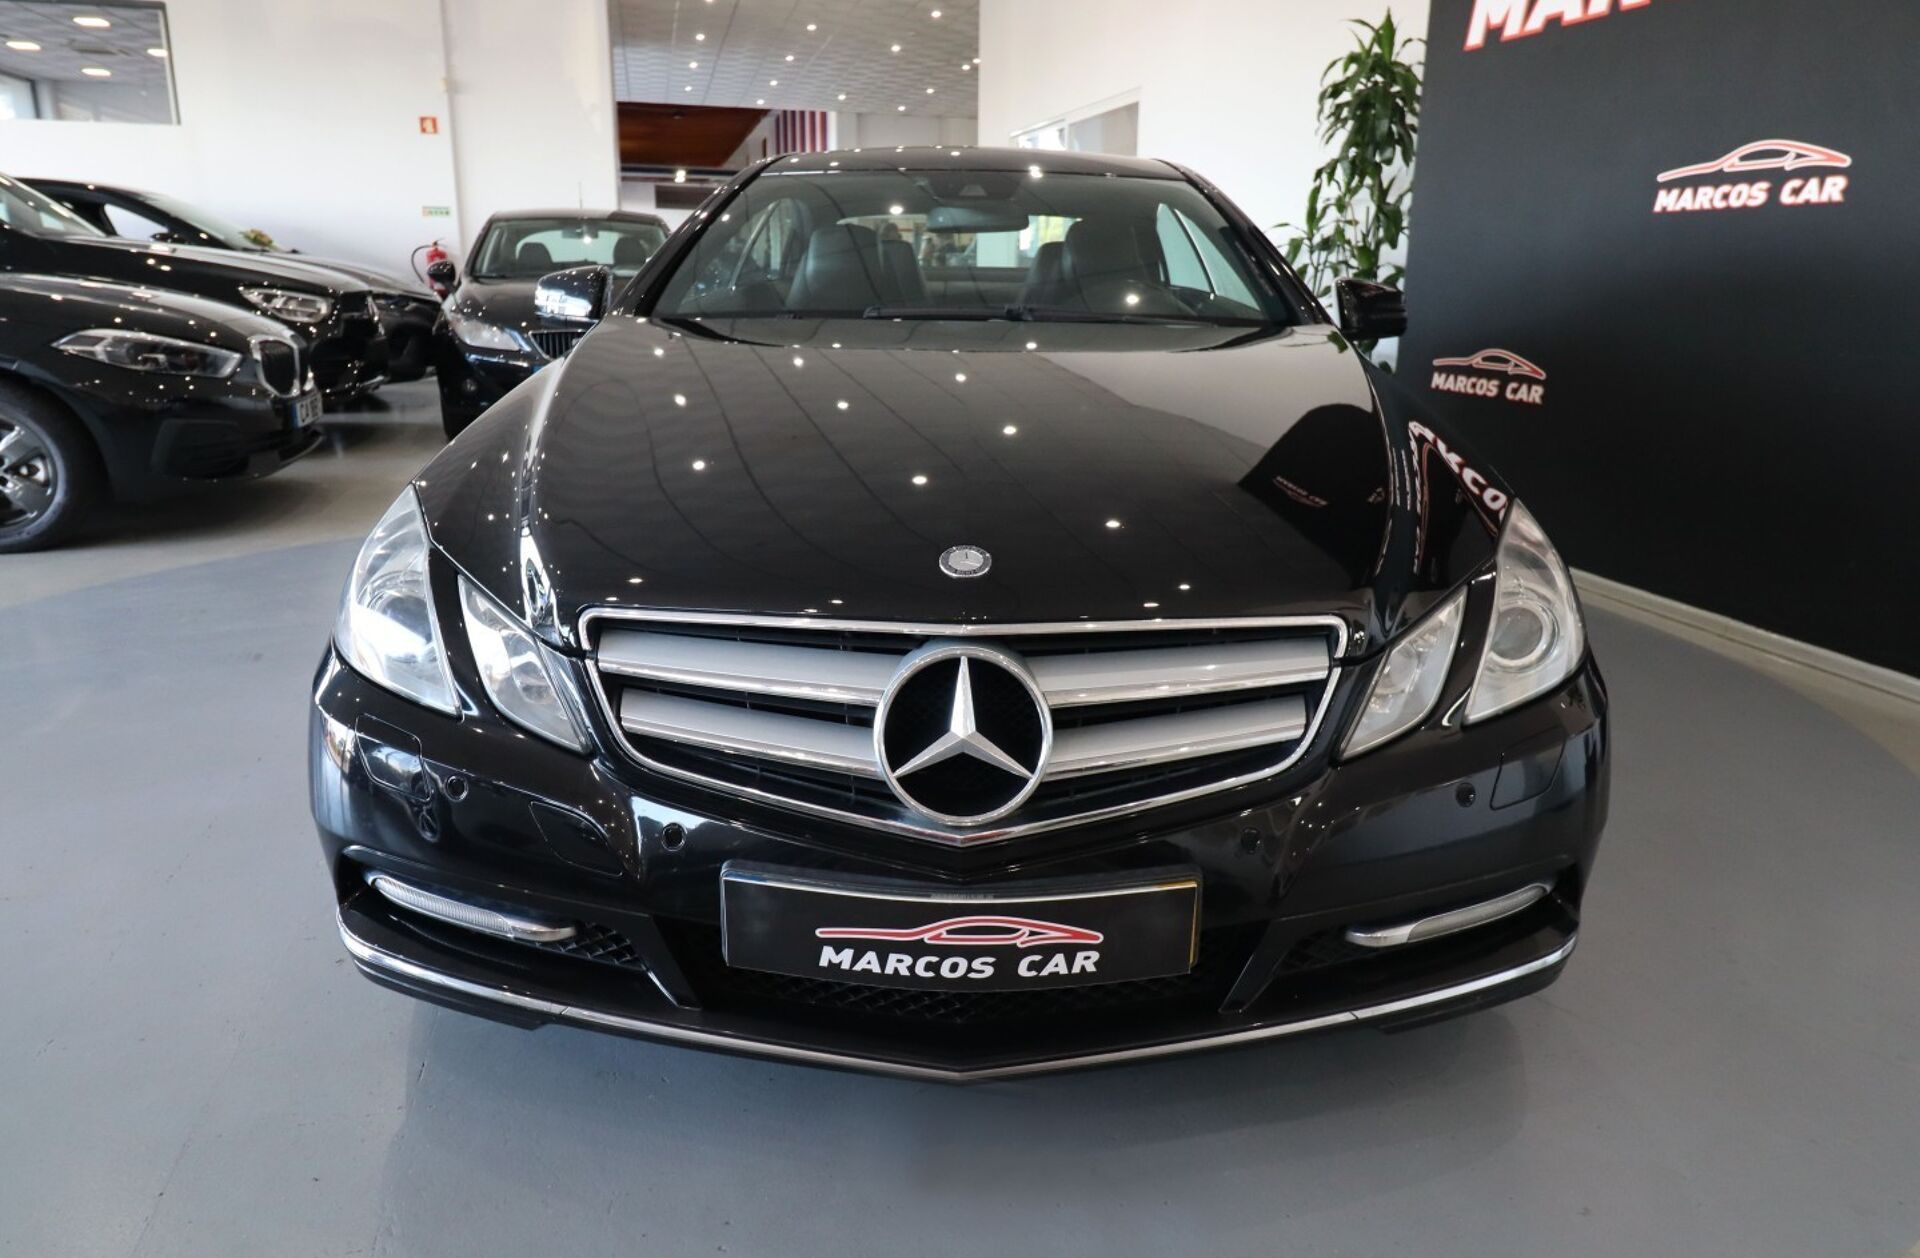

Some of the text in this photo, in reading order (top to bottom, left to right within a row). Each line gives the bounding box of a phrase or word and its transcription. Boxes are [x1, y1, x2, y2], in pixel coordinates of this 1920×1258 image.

[1653, 174, 1849, 213] MARCOS CAR
[1431, 371, 1544, 404] MARCOS CAR
[819, 946, 1100, 979] MARCOS CAR
